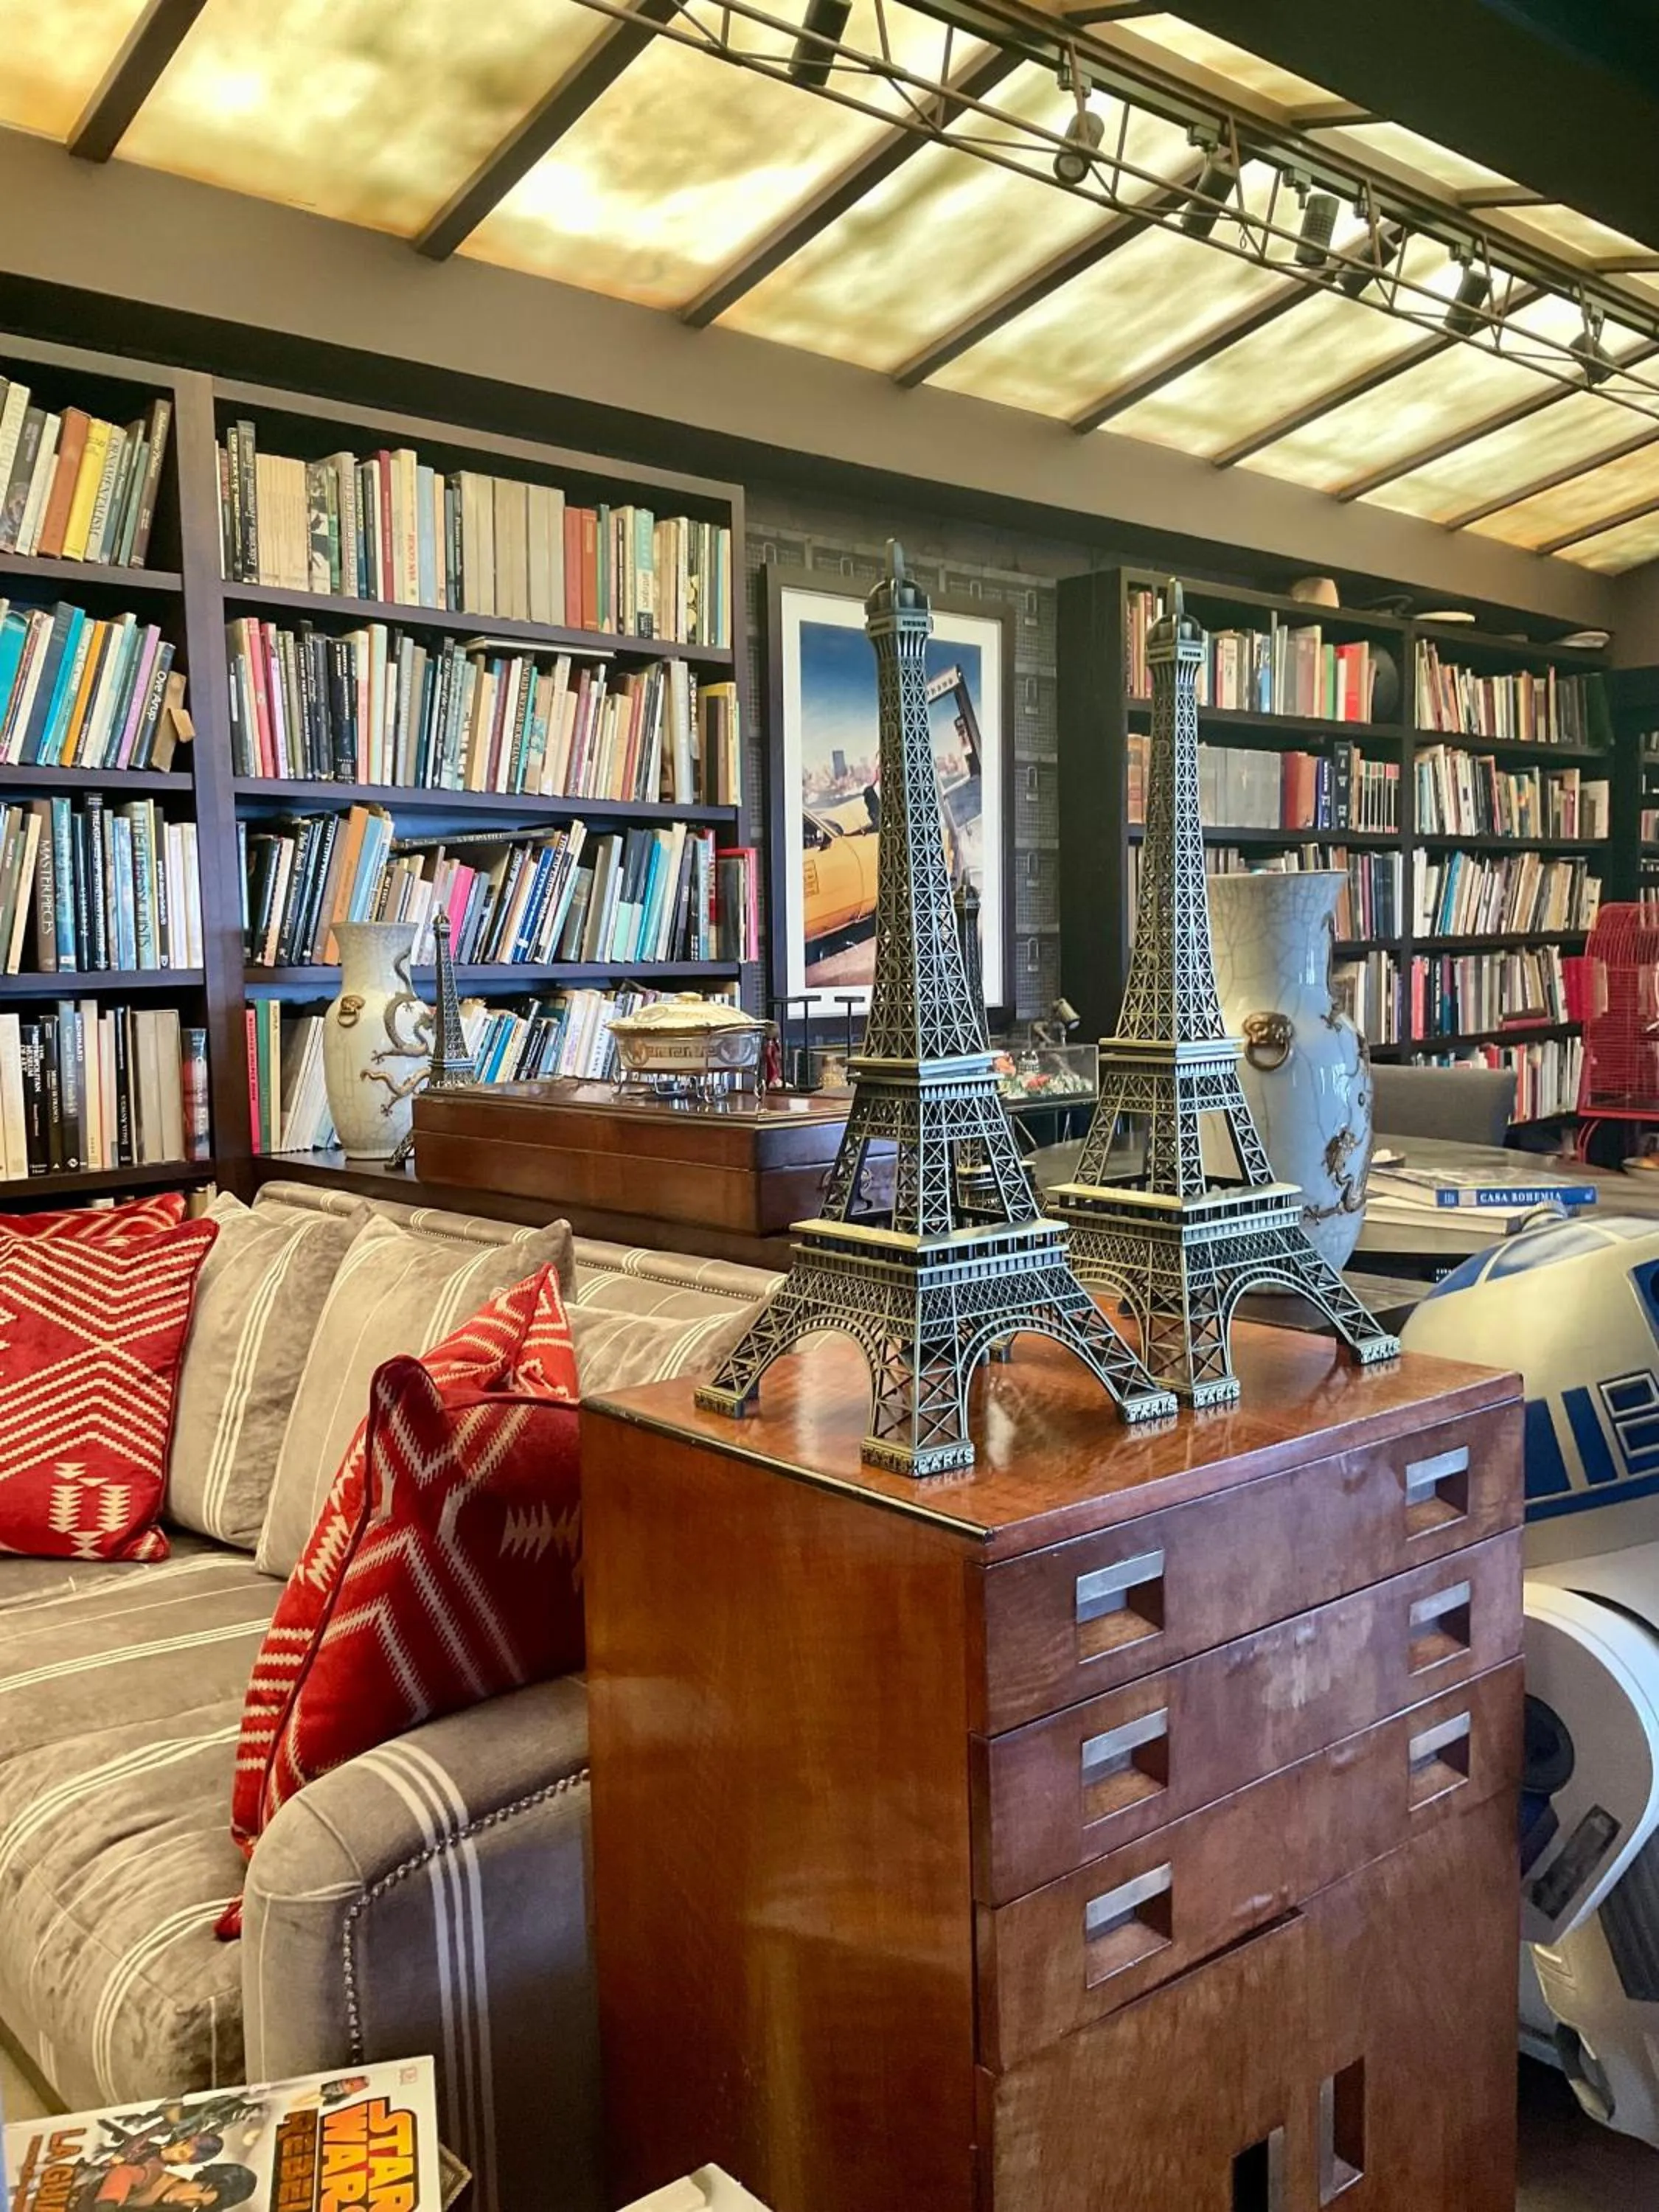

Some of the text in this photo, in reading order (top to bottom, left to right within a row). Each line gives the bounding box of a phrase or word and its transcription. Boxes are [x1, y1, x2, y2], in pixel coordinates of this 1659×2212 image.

[147, 671, 167, 722] Ove Arup
[40, 839, 54, 935] MASTERPIECES
[1480, 1191, 1561, 1203] CASA BOHEMIA
[1128, 1396, 1178, 1423] PARIS
[1195, 1382, 1240, 1408] PARIS
[918, 1447, 974, 1474] PARIS
[44, 2127, 87, 2164] LA
[320, 2101, 369, 2212] WAR
